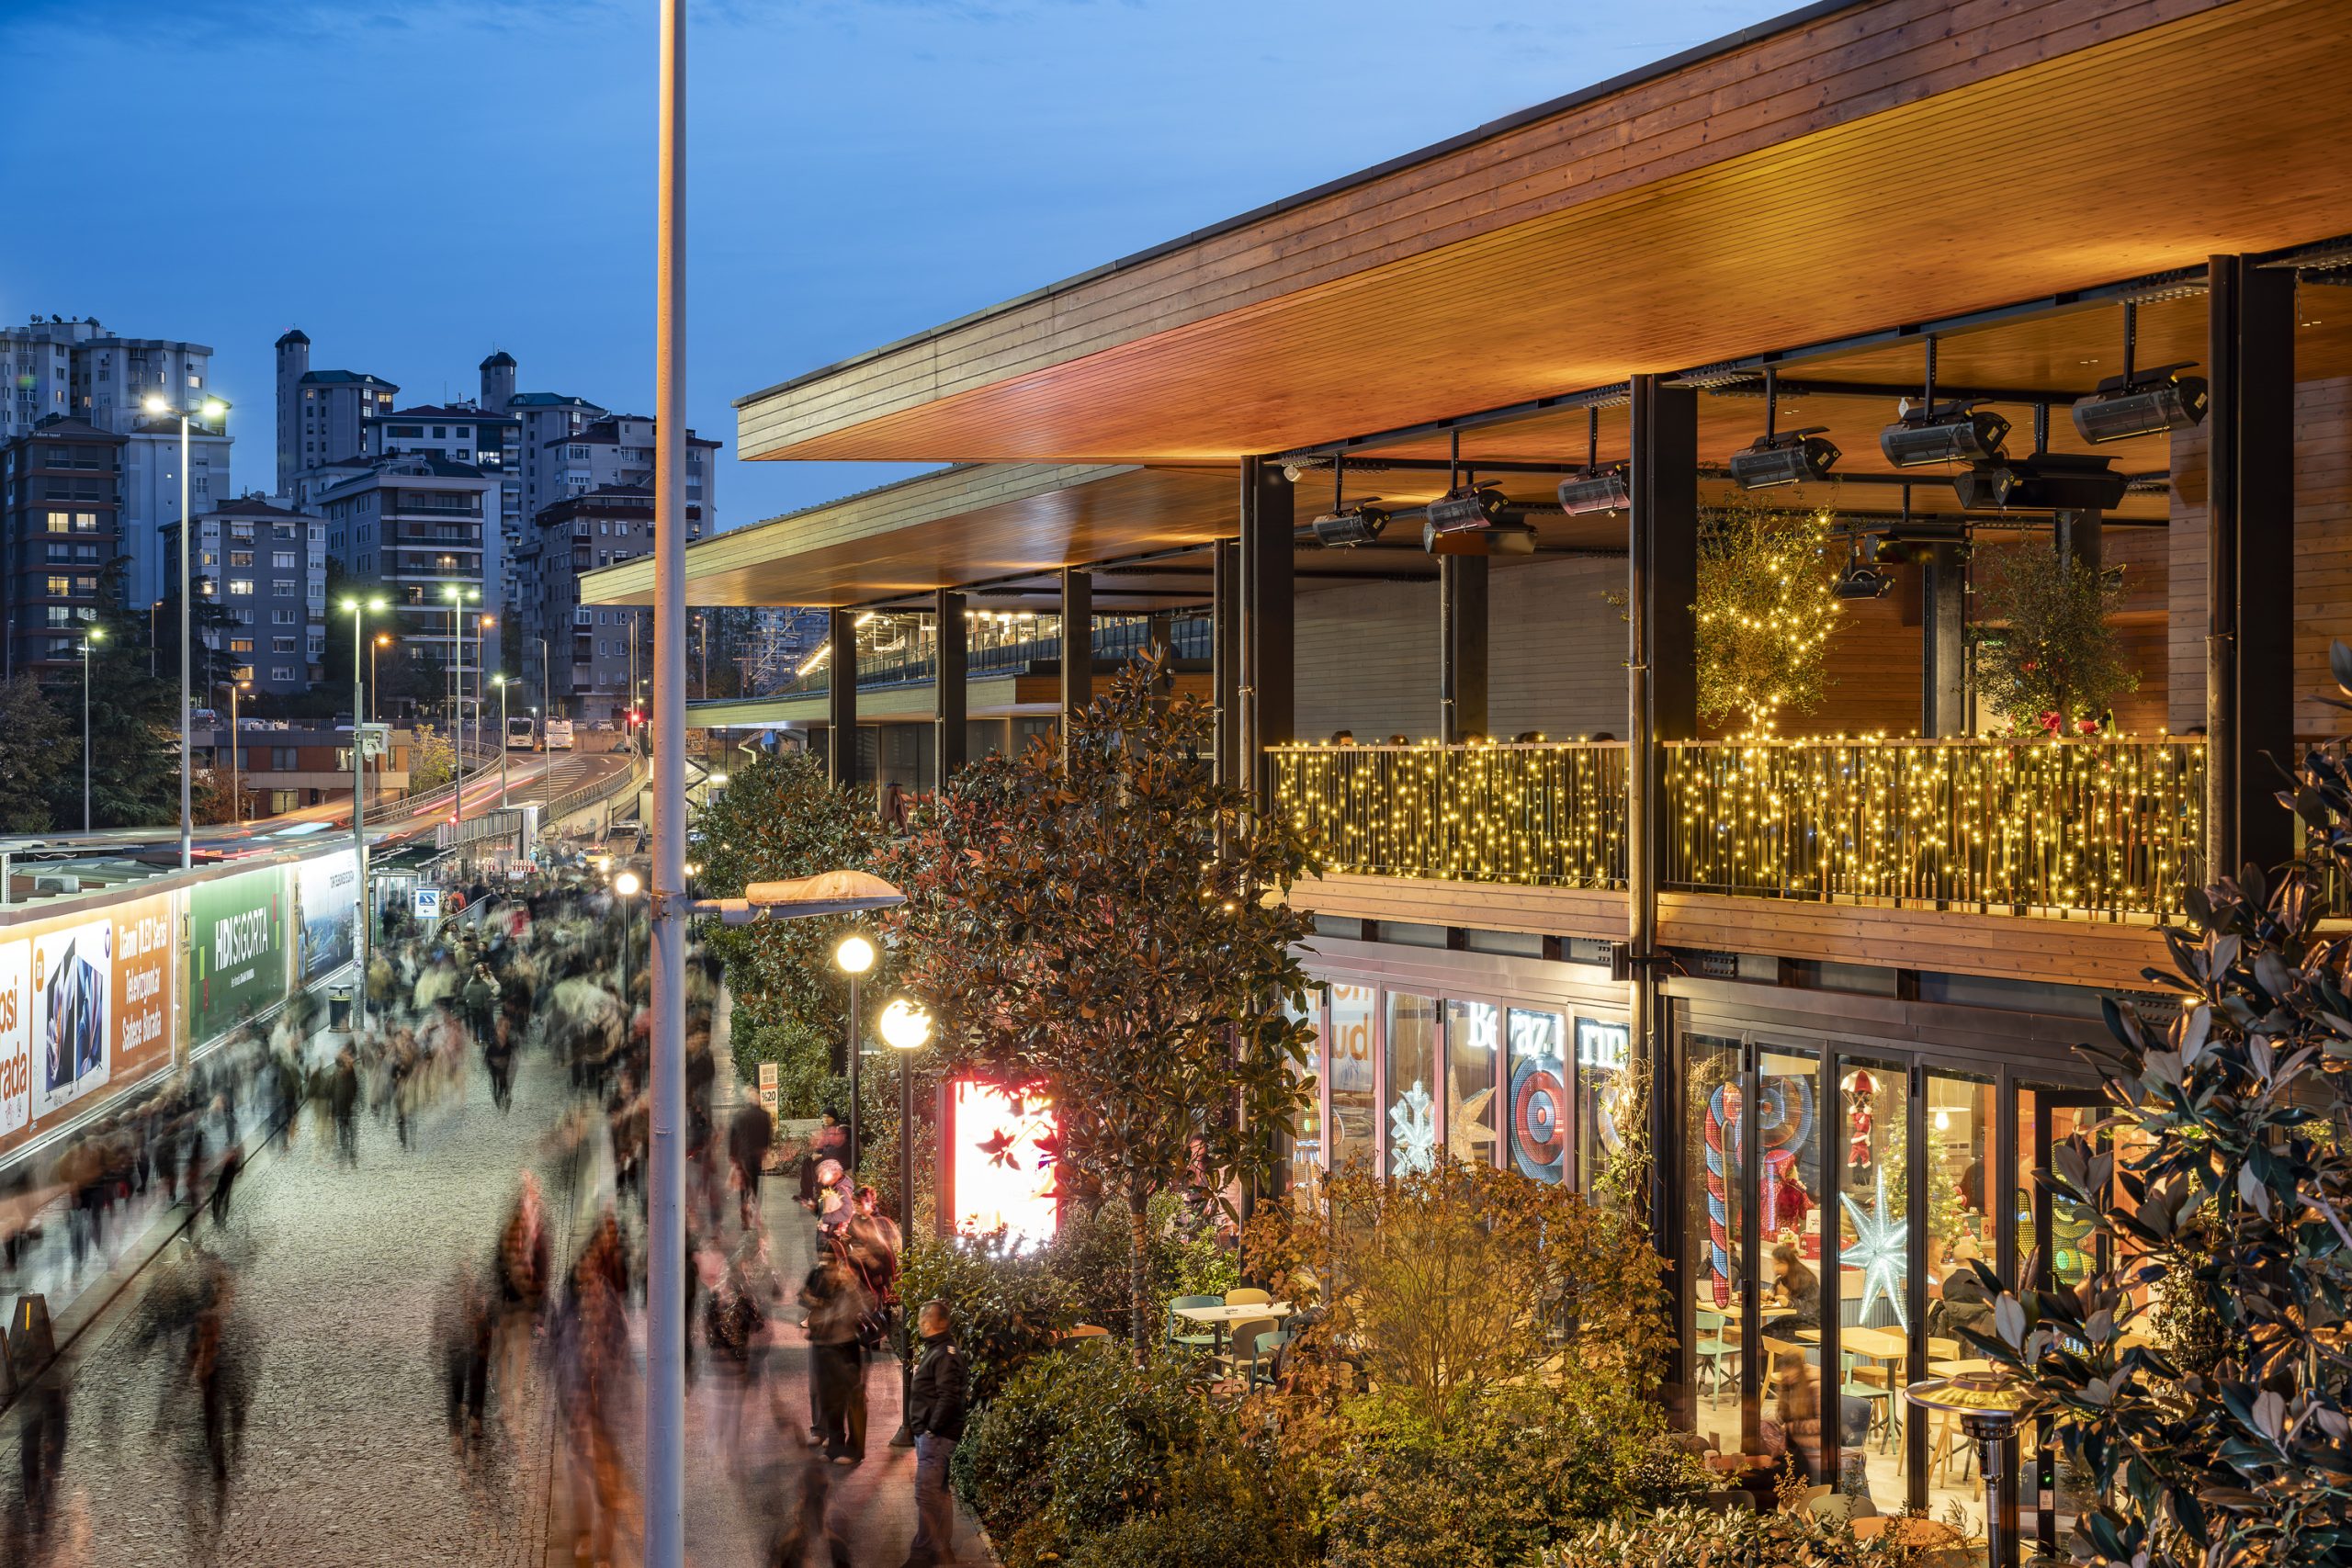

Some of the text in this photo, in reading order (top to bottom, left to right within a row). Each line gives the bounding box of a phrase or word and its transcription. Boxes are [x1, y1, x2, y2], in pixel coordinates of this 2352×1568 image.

[119, 914, 168, 961] Xiaomi QLED Serisi
[125, 961, 161, 1005] Televizyonlar
[122, 1002, 162, 1054] Sadece Burada
